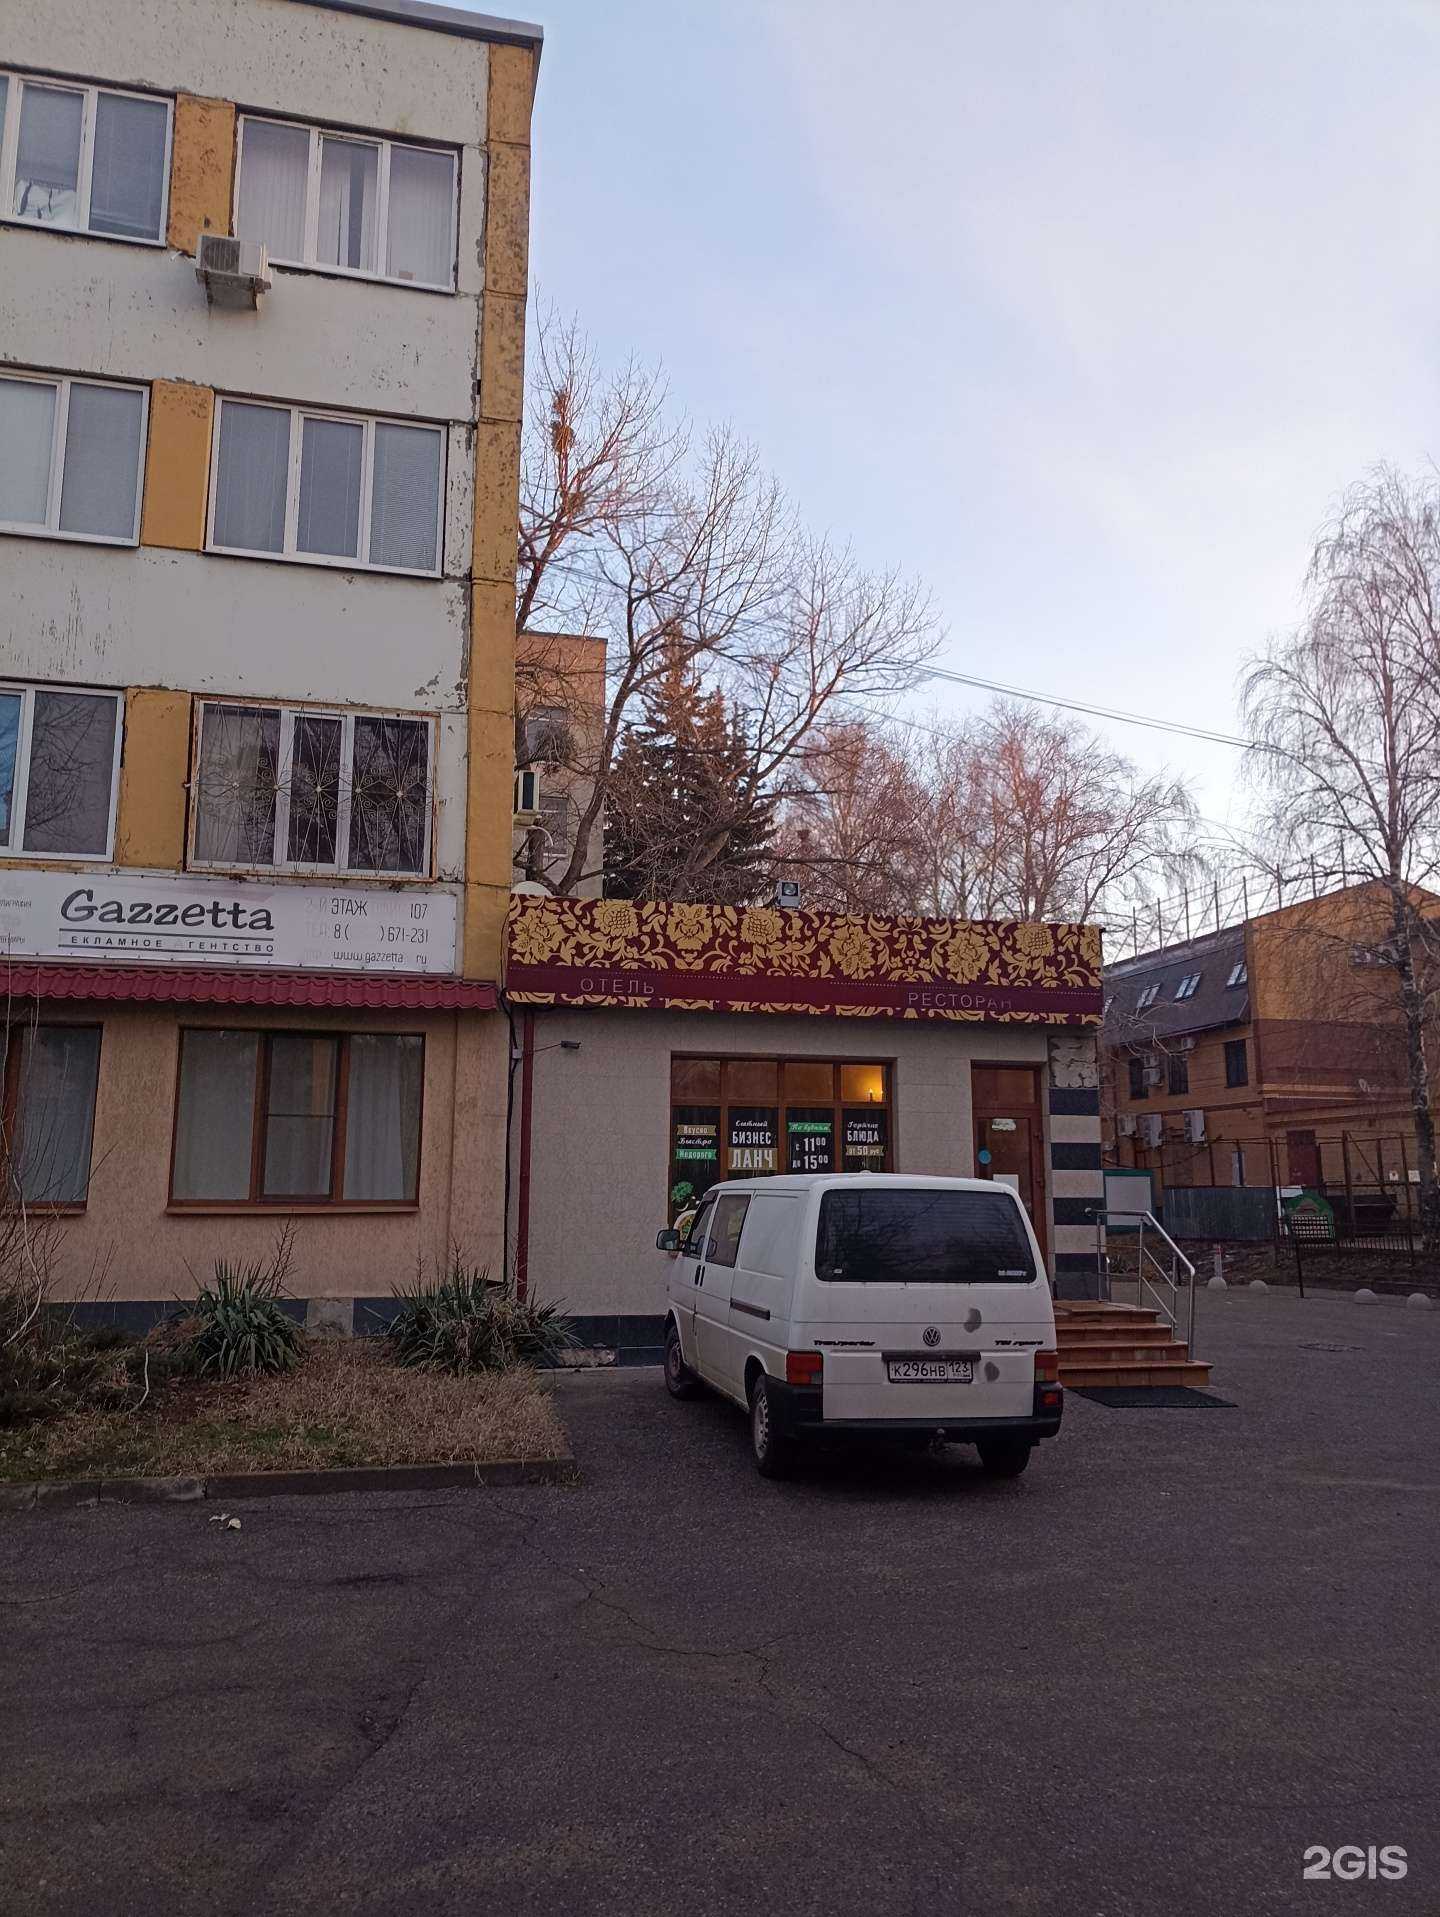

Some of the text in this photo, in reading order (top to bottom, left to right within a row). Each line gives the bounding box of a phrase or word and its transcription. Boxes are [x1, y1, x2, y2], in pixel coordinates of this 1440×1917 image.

[60, 888, 275, 931] Gazzetta
[331, 898, 368, 917] ЭТАЖ
[410, 903, 428, 920] 107
[71, 935, 274, 953] ЕКЛАМНОЕ ГЕНТСТВО
[580, 978, 655, 994] ОТЕЛЬ
[907, 992, 1012, 1009] РЕСТОРАН
[683, 1125, 708, 1135] Вкусно
[732, 1131, 772, 1145] БИЗНЕС
[847, 1131, 879, 1144] БЛЮДА
[679, 1150, 712, 1160] Недорого
[732, 1149, 773, 1168] ЛАНЧ
[857, 1146, 868, 1156] 50
